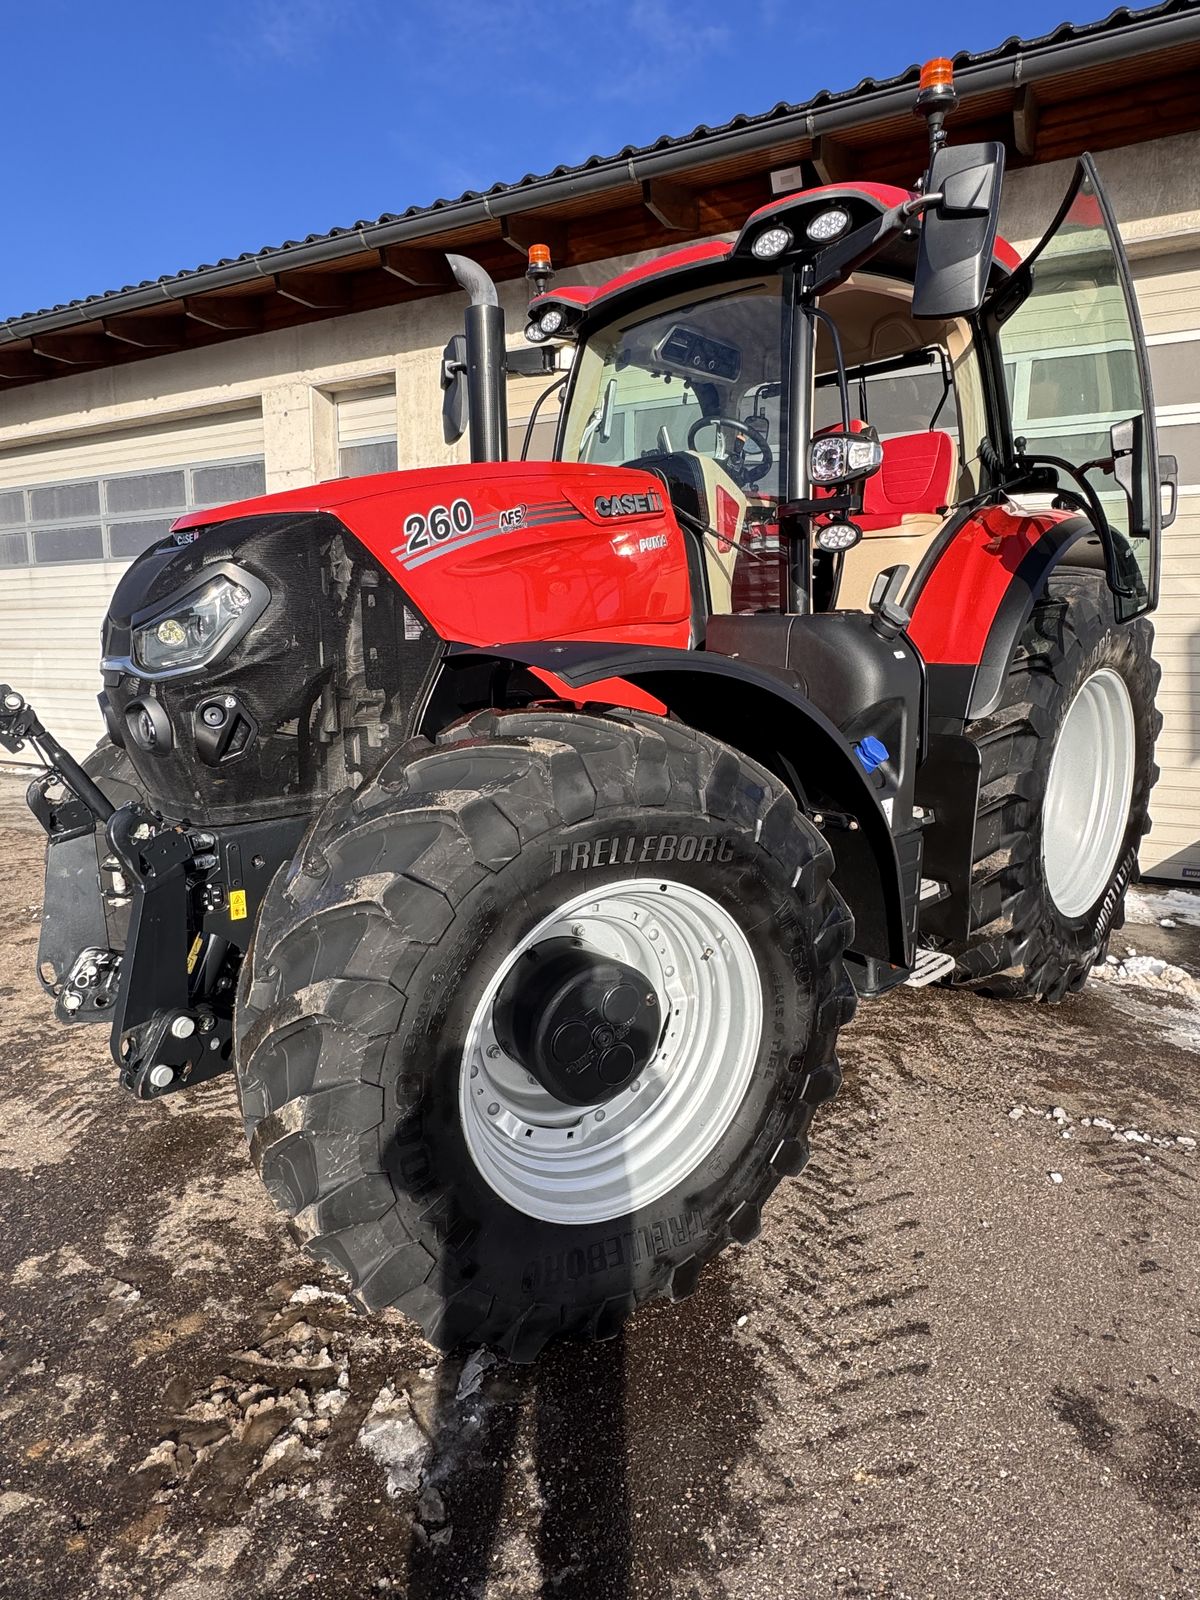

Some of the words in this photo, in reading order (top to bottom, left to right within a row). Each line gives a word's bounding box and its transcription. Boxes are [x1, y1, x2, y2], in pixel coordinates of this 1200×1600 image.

[404, 499, 473, 554] 260
[500, 508, 523, 527] AFS
[594, 494, 647, 517] CASE
[639, 535, 668, 553] PUMA
[548, 832, 737, 874] TRELLEBORG
[1094, 847, 1137, 943] TRELLEBORG
[520, 1209, 708, 1293] TRELLEBORG
